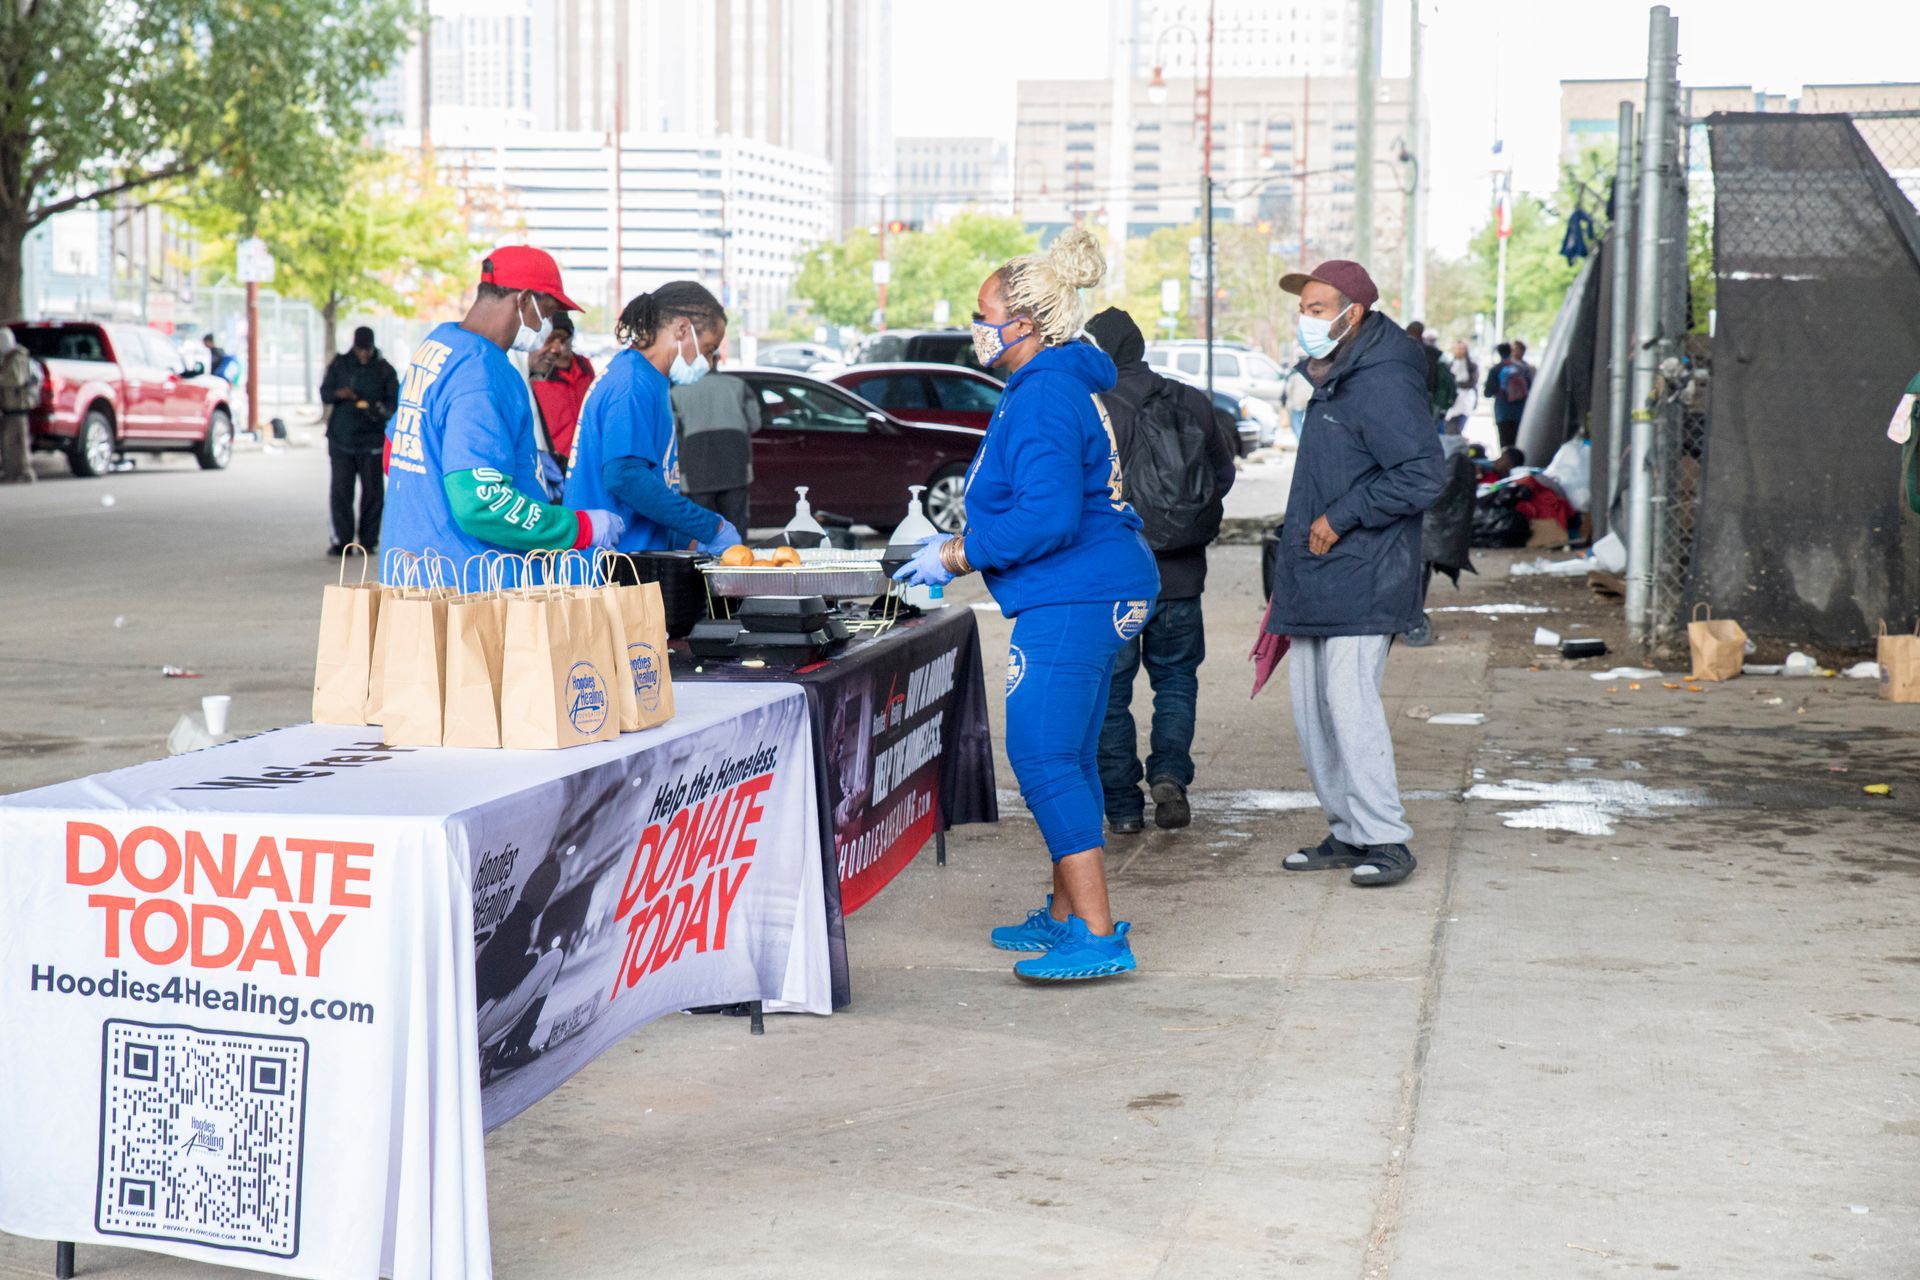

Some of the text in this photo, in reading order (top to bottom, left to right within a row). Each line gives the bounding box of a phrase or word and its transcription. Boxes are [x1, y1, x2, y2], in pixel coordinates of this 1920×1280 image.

[572, 673, 596, 691] Hoodies
[580, 689, 604, 706] Healing
[648, 740, 777, 824] Help the Homeless.
[872, 746, 893, 807] HELP
[65, 821, 375, 908] DONATE
[472, 842, 519, 893] Hoodies
[613, 773, 774, 923] DONATE
[88, 894, 347, 977] TODAY
[610, 862, 752, 1001] TODAY
[31, 964, 374, 1024] Hoodies4Healing.com
[191, 1116, 216, 1134] Hoodies
[198, 1130, 224, 1151] Healing
[117, 1208, 155, 1218] FLOWCODE
